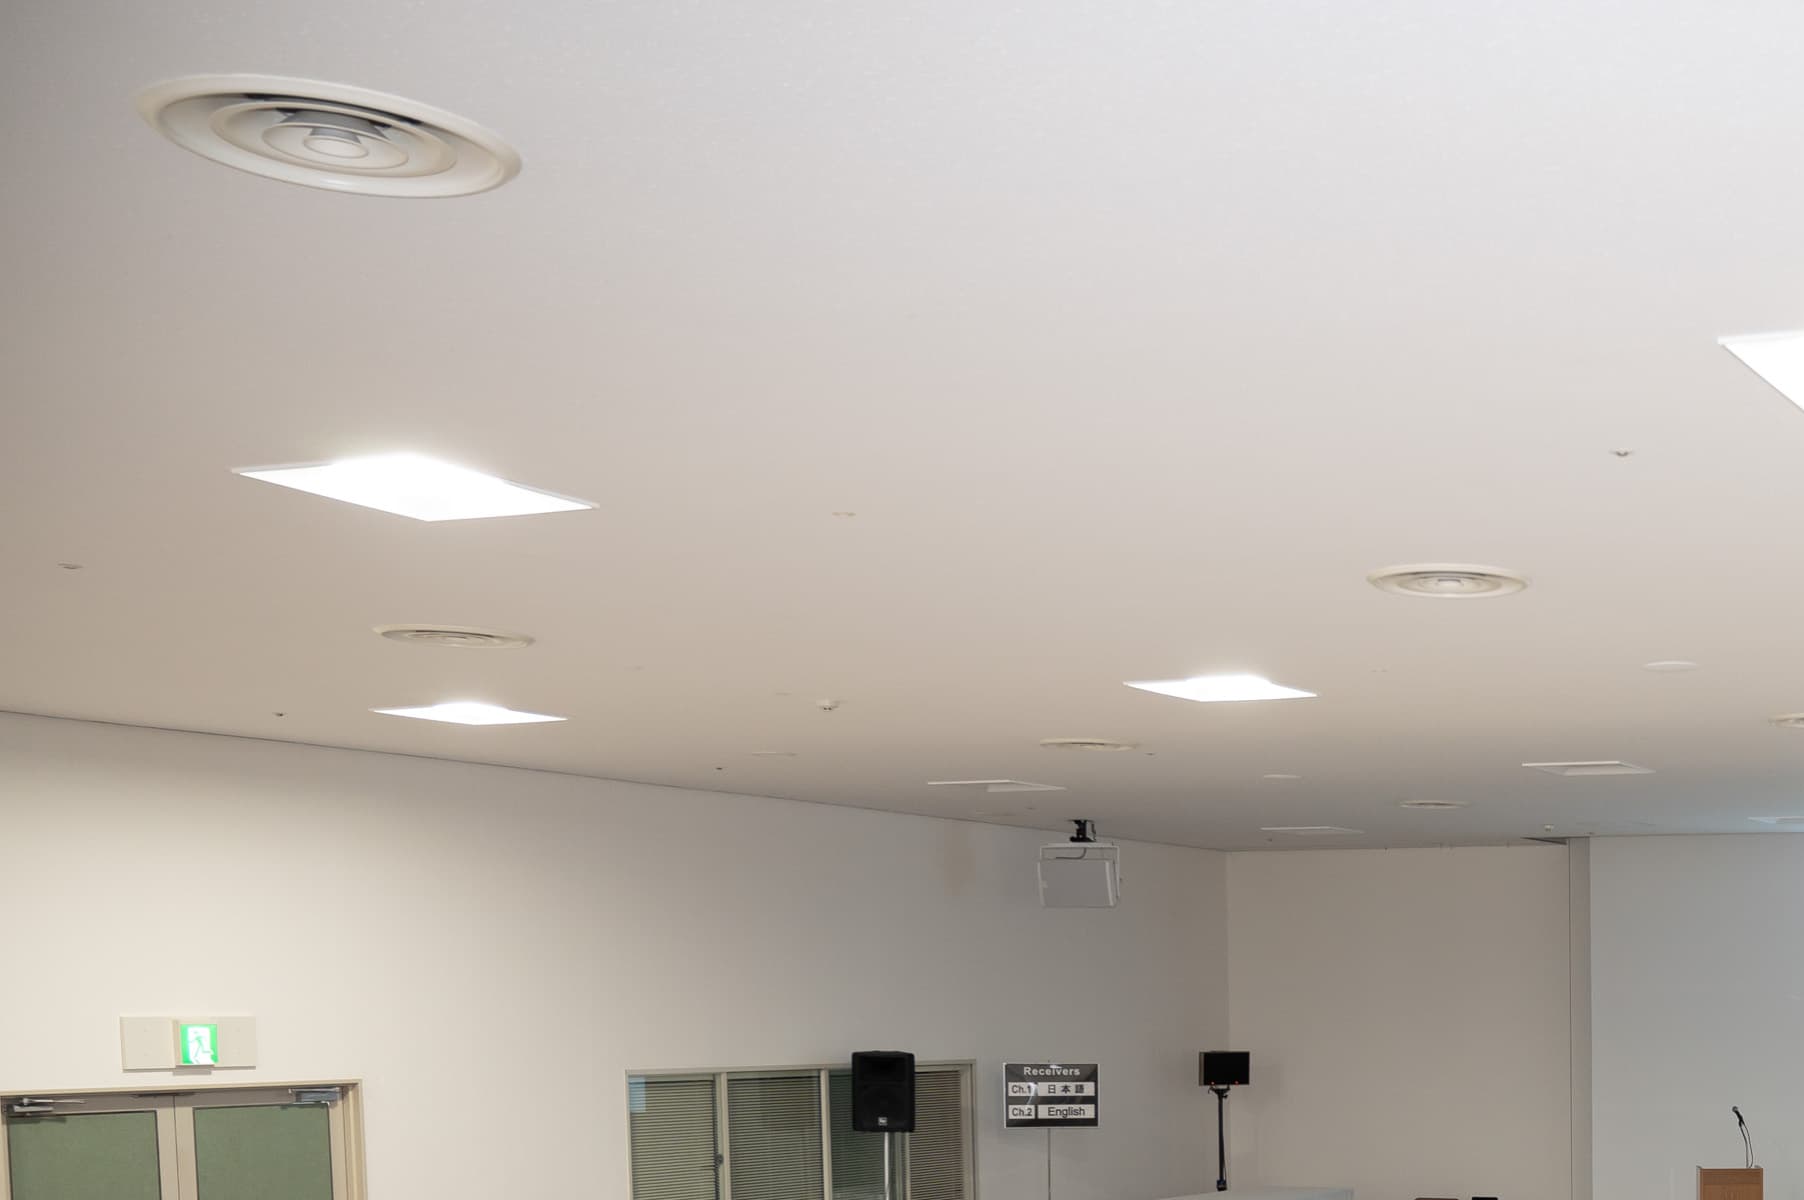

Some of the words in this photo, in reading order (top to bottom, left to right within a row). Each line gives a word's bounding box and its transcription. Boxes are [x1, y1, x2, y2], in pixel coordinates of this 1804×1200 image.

[1023, 1066, 1081, 1077] Receivers
[1011, 1084, 1032, 1094] Ch.1
[1047, 1084, 1085, 1095] 日本語
[1011, 1107, 1033, 1117] Ch.2
[1047, 1106, 1086, 1119] English
